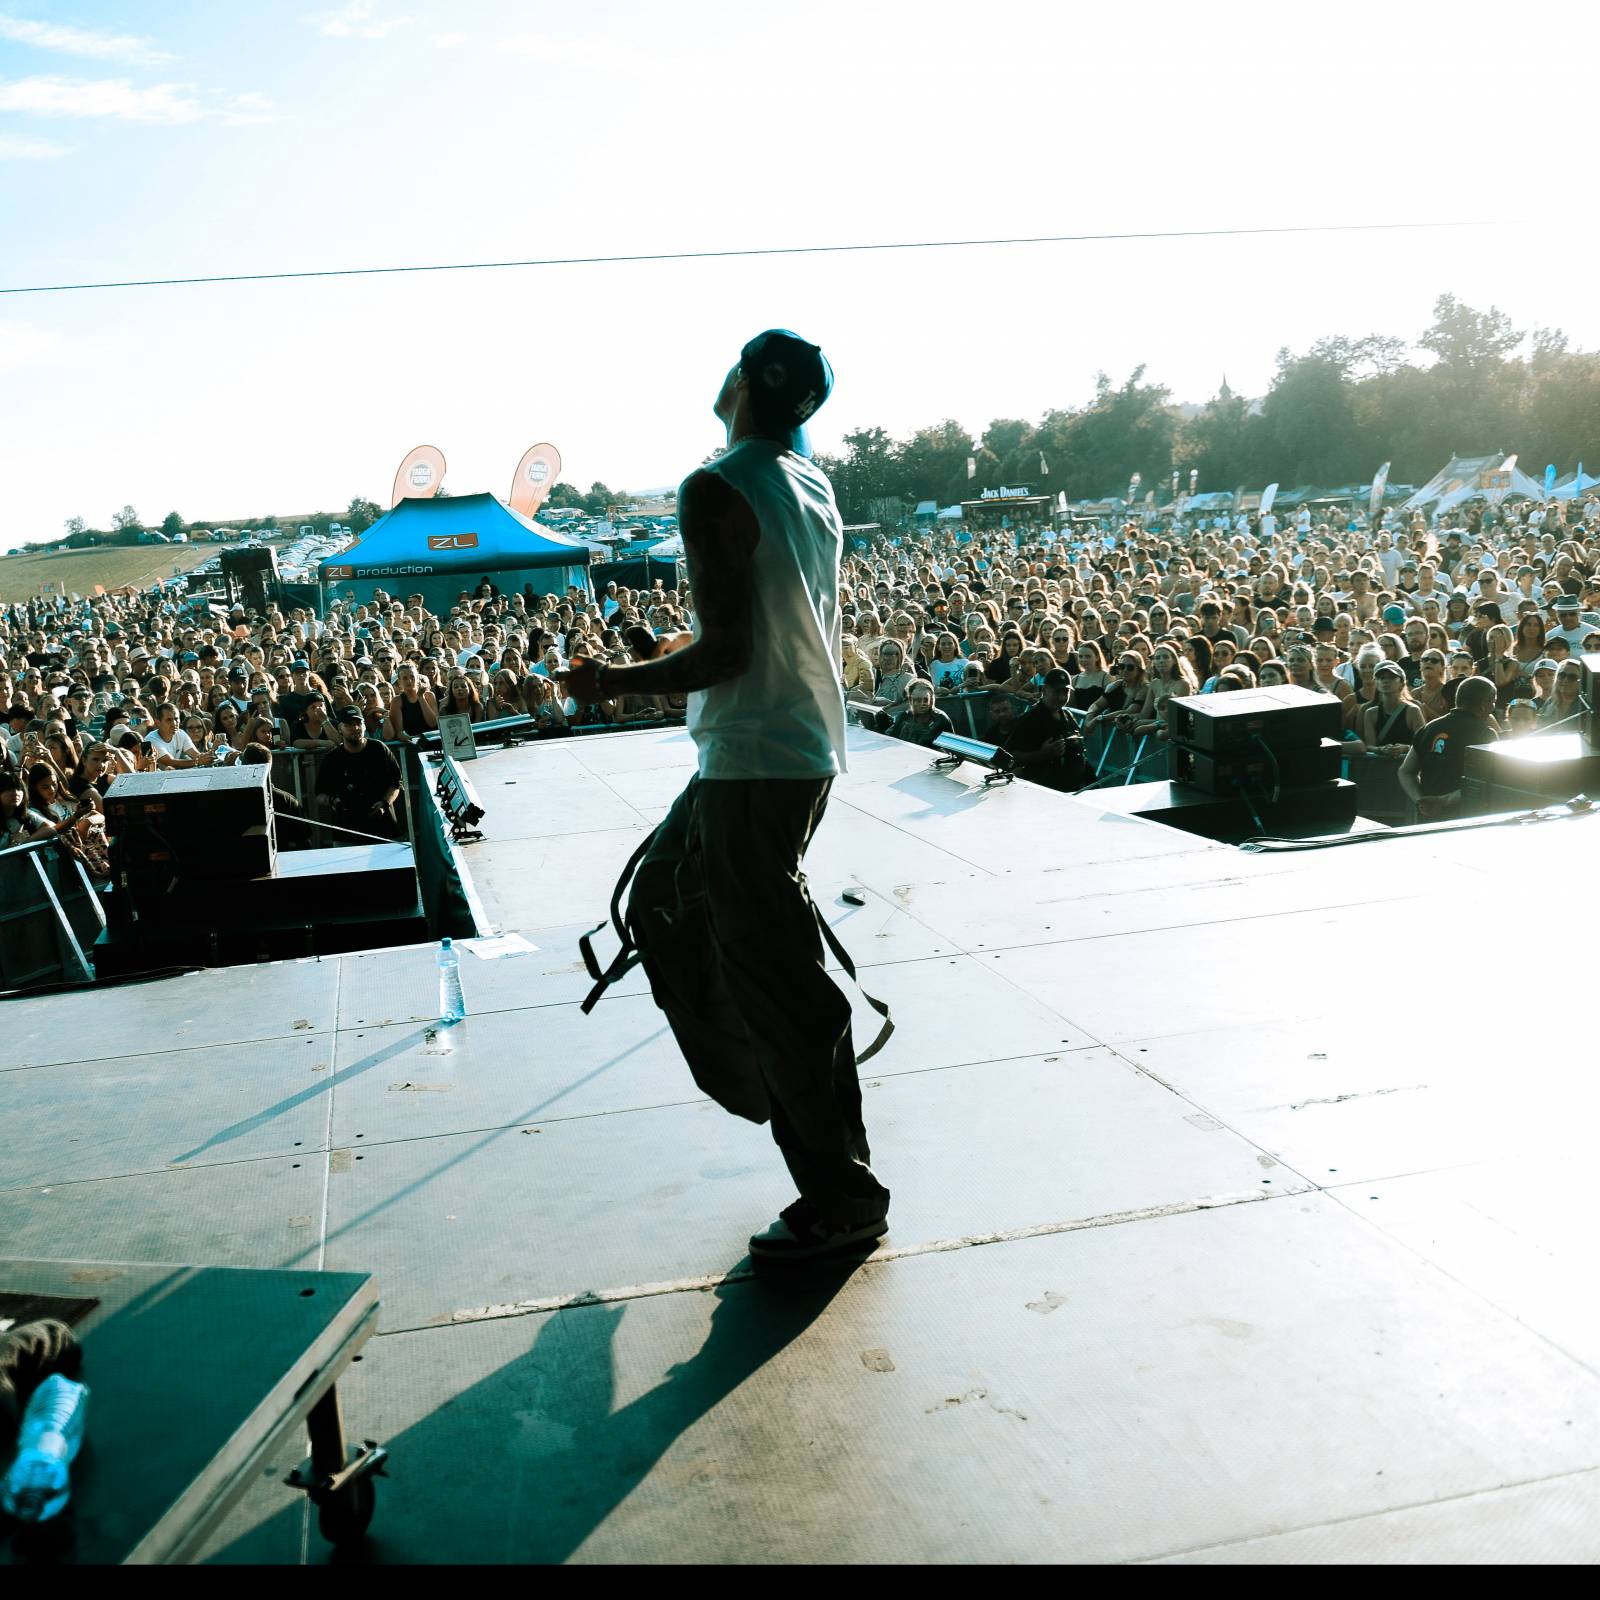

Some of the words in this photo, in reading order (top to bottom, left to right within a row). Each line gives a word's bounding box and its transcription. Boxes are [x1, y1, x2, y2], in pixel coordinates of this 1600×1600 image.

[793, 389, 816, 418] LA
[980, 487, 999, 499] JACK
[1000, 486, 1029, 498] DANIEL'S
[432, 537, 474, 549] ZL
[328, 567, 350, 577] ZL
[356, 565, 433, 578] production
